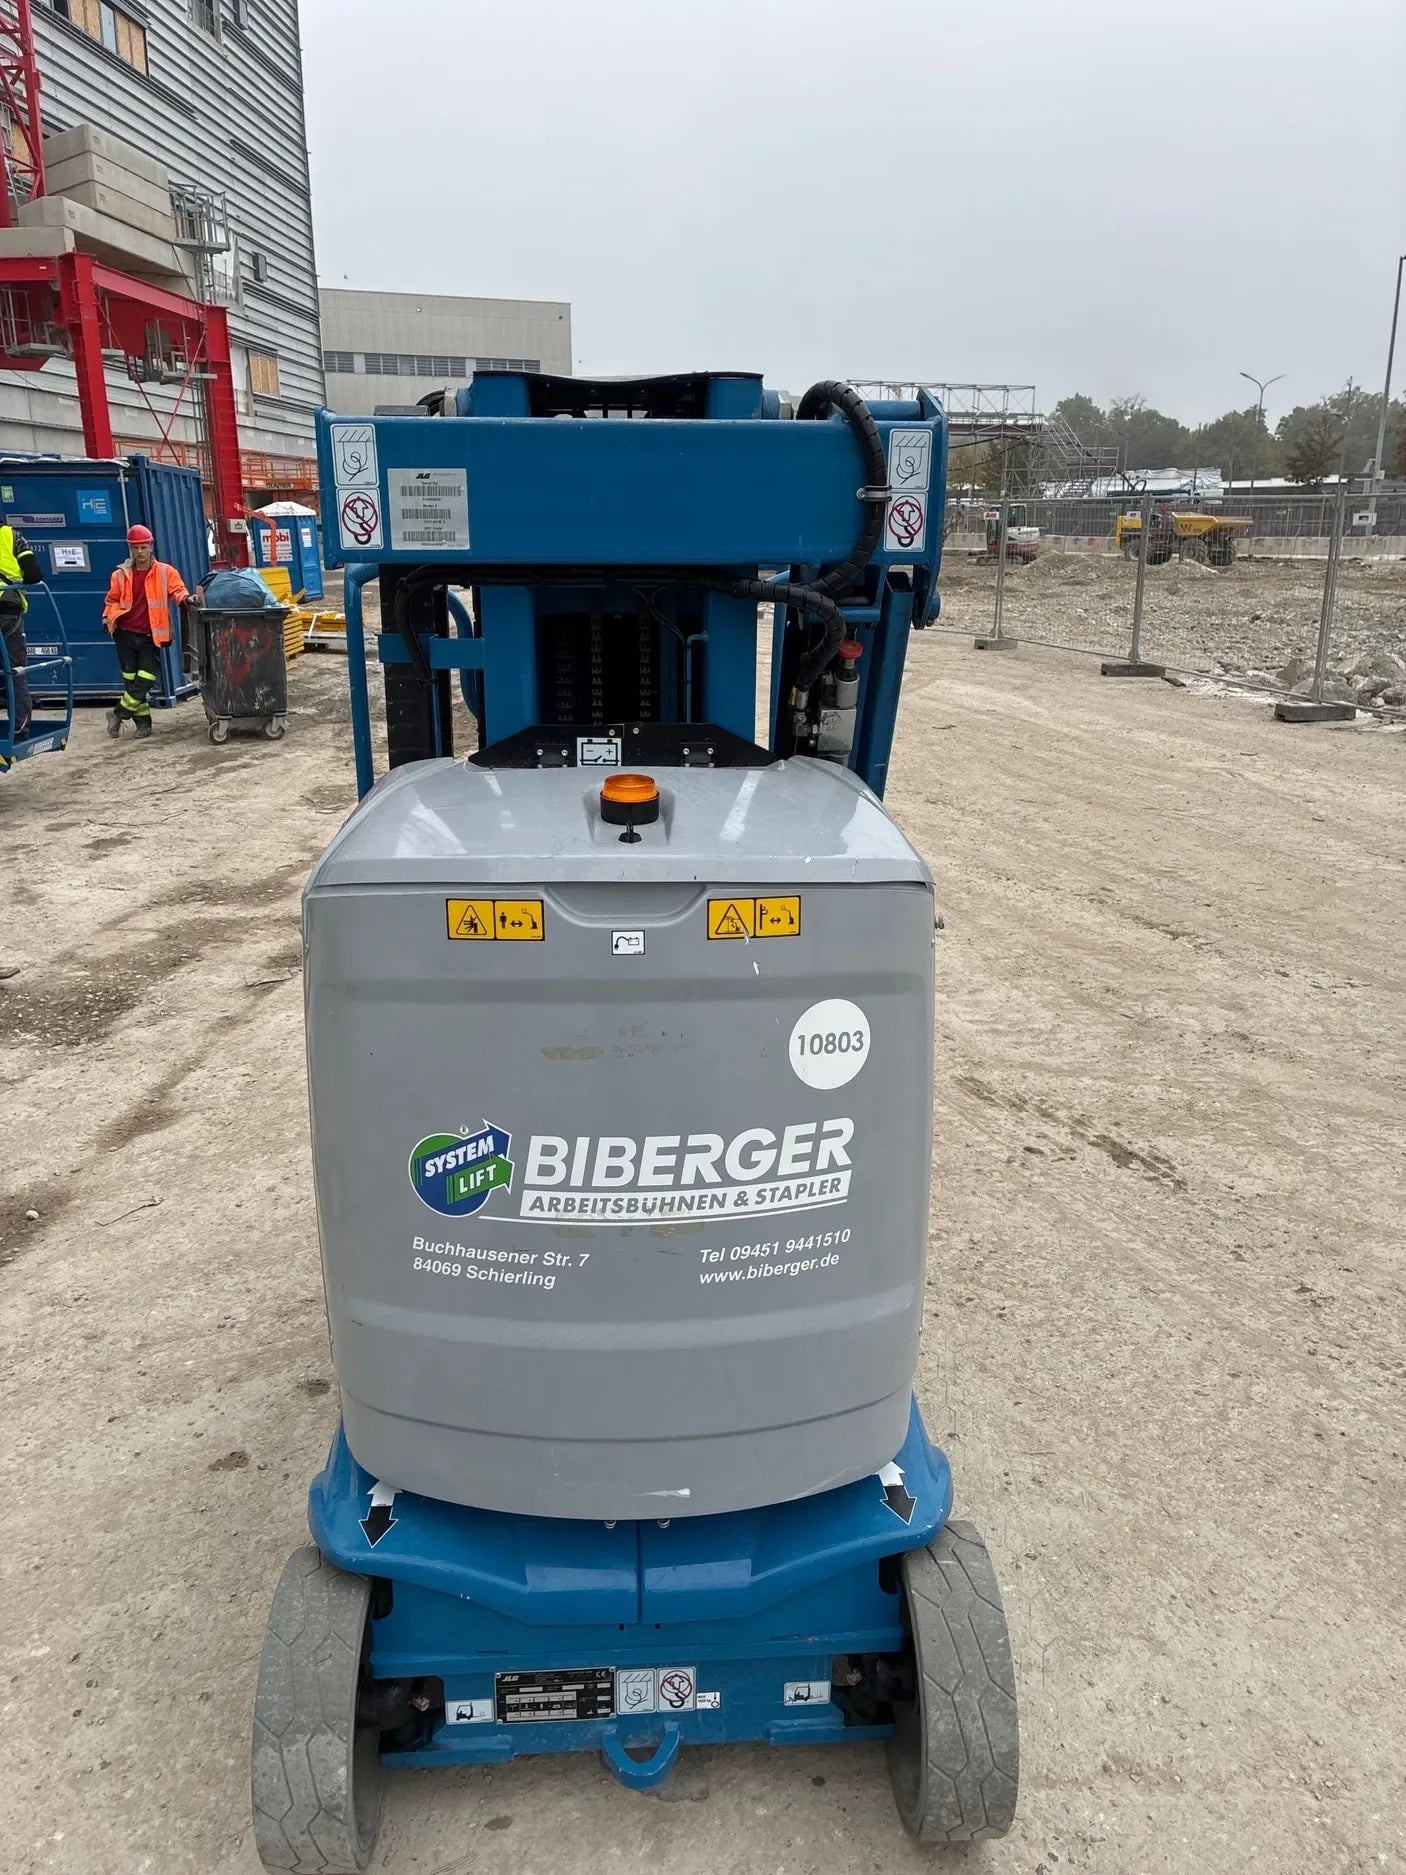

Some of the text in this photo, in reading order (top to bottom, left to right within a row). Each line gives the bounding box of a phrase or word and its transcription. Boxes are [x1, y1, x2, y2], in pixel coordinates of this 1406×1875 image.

[797, 1030, 864, 1056] 10803
[425, 1135, 494, 1178] SYSTEM
[524, 1118, 855, 1187] BIBERGER
[459, 1164, 497, 1194] LIFT
[733, 1190, 750, 1208] &
[754, 1176, 842, 1206] STAPLER
[412, 1236, 591, 1268] Buchhausener Str. 7
[700, 1229, 851, 1264] Tel 09451 9441510
[413, 1256, 556, 1290] 84069 Schierling
[699, 1252, 840, 1284] www.biberger.de
